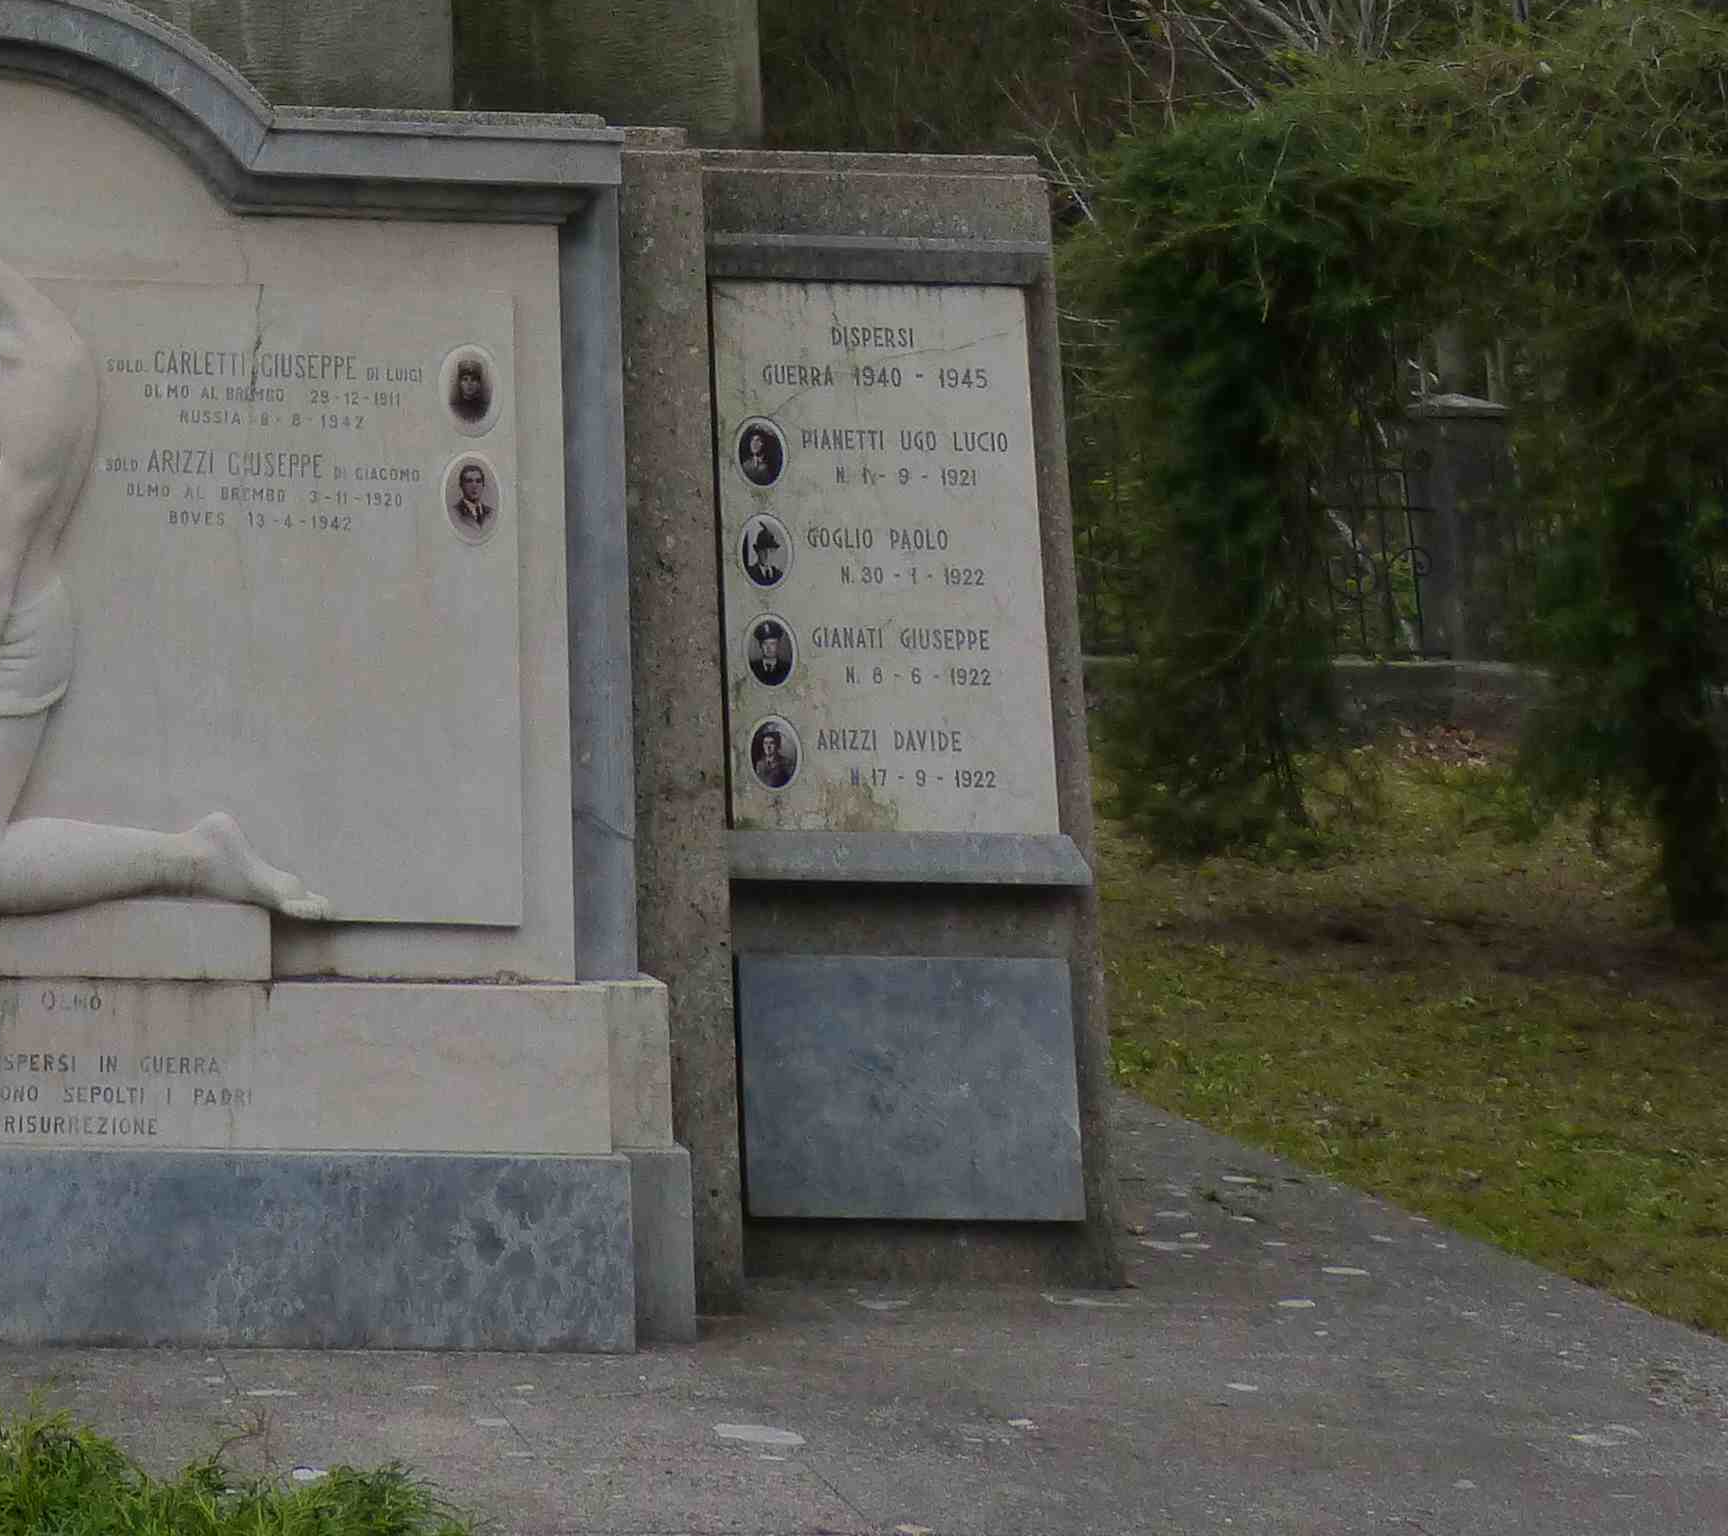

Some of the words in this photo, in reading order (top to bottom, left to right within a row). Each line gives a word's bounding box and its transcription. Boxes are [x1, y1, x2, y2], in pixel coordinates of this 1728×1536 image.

[832, 326, 914, 348] DISPERSI
[154, 351, 246, 376] CARLETTI
[259, 354, 357, 380] GIUSEPPE
[762, 364, 834, 387] GUERRA
[854, 367, 902, 387] 1940
[939, 368, 989, 388] 1945
[145, 385, 190, 399] OLMO
[180, 410, 241, 425] RUSSIA
[802, 429, 884, 450] PIANETTI
[901, 430, 937, 450] UGO
[953, 431, 1008, 453] LUCIO
[147, 450, 214, 475] ARIZZI
[228, 453, 322, 478] GIUSEPPE
[941, 468, 977, 486] 1921
[127, 485, 171, 498] OLMO
[168, 510, 225, 526] BOVES
[807, 528, 872, 550] GOGLIO
[890, 529, 948, 550] PAOLO
[944, 568, 985, 586] 1922
[812, 628, 883, 648] GIANATI
[899, 629, 990, 650] GIUSEPPE
[950, 668, 992, 686] 1922
[817, 730, 877, 750] ARIZZI
[894, 730, 963, 752] DAVIDE
[954, 771, 997, 789] 1922
[99, 1055, 118, 1074] IN
[64, 1086, 145, 1105] SEPOLTI
[193, 1087, 253, 1106] PADRI
[4, 1115, 158, 1136] RISURREZIONE
